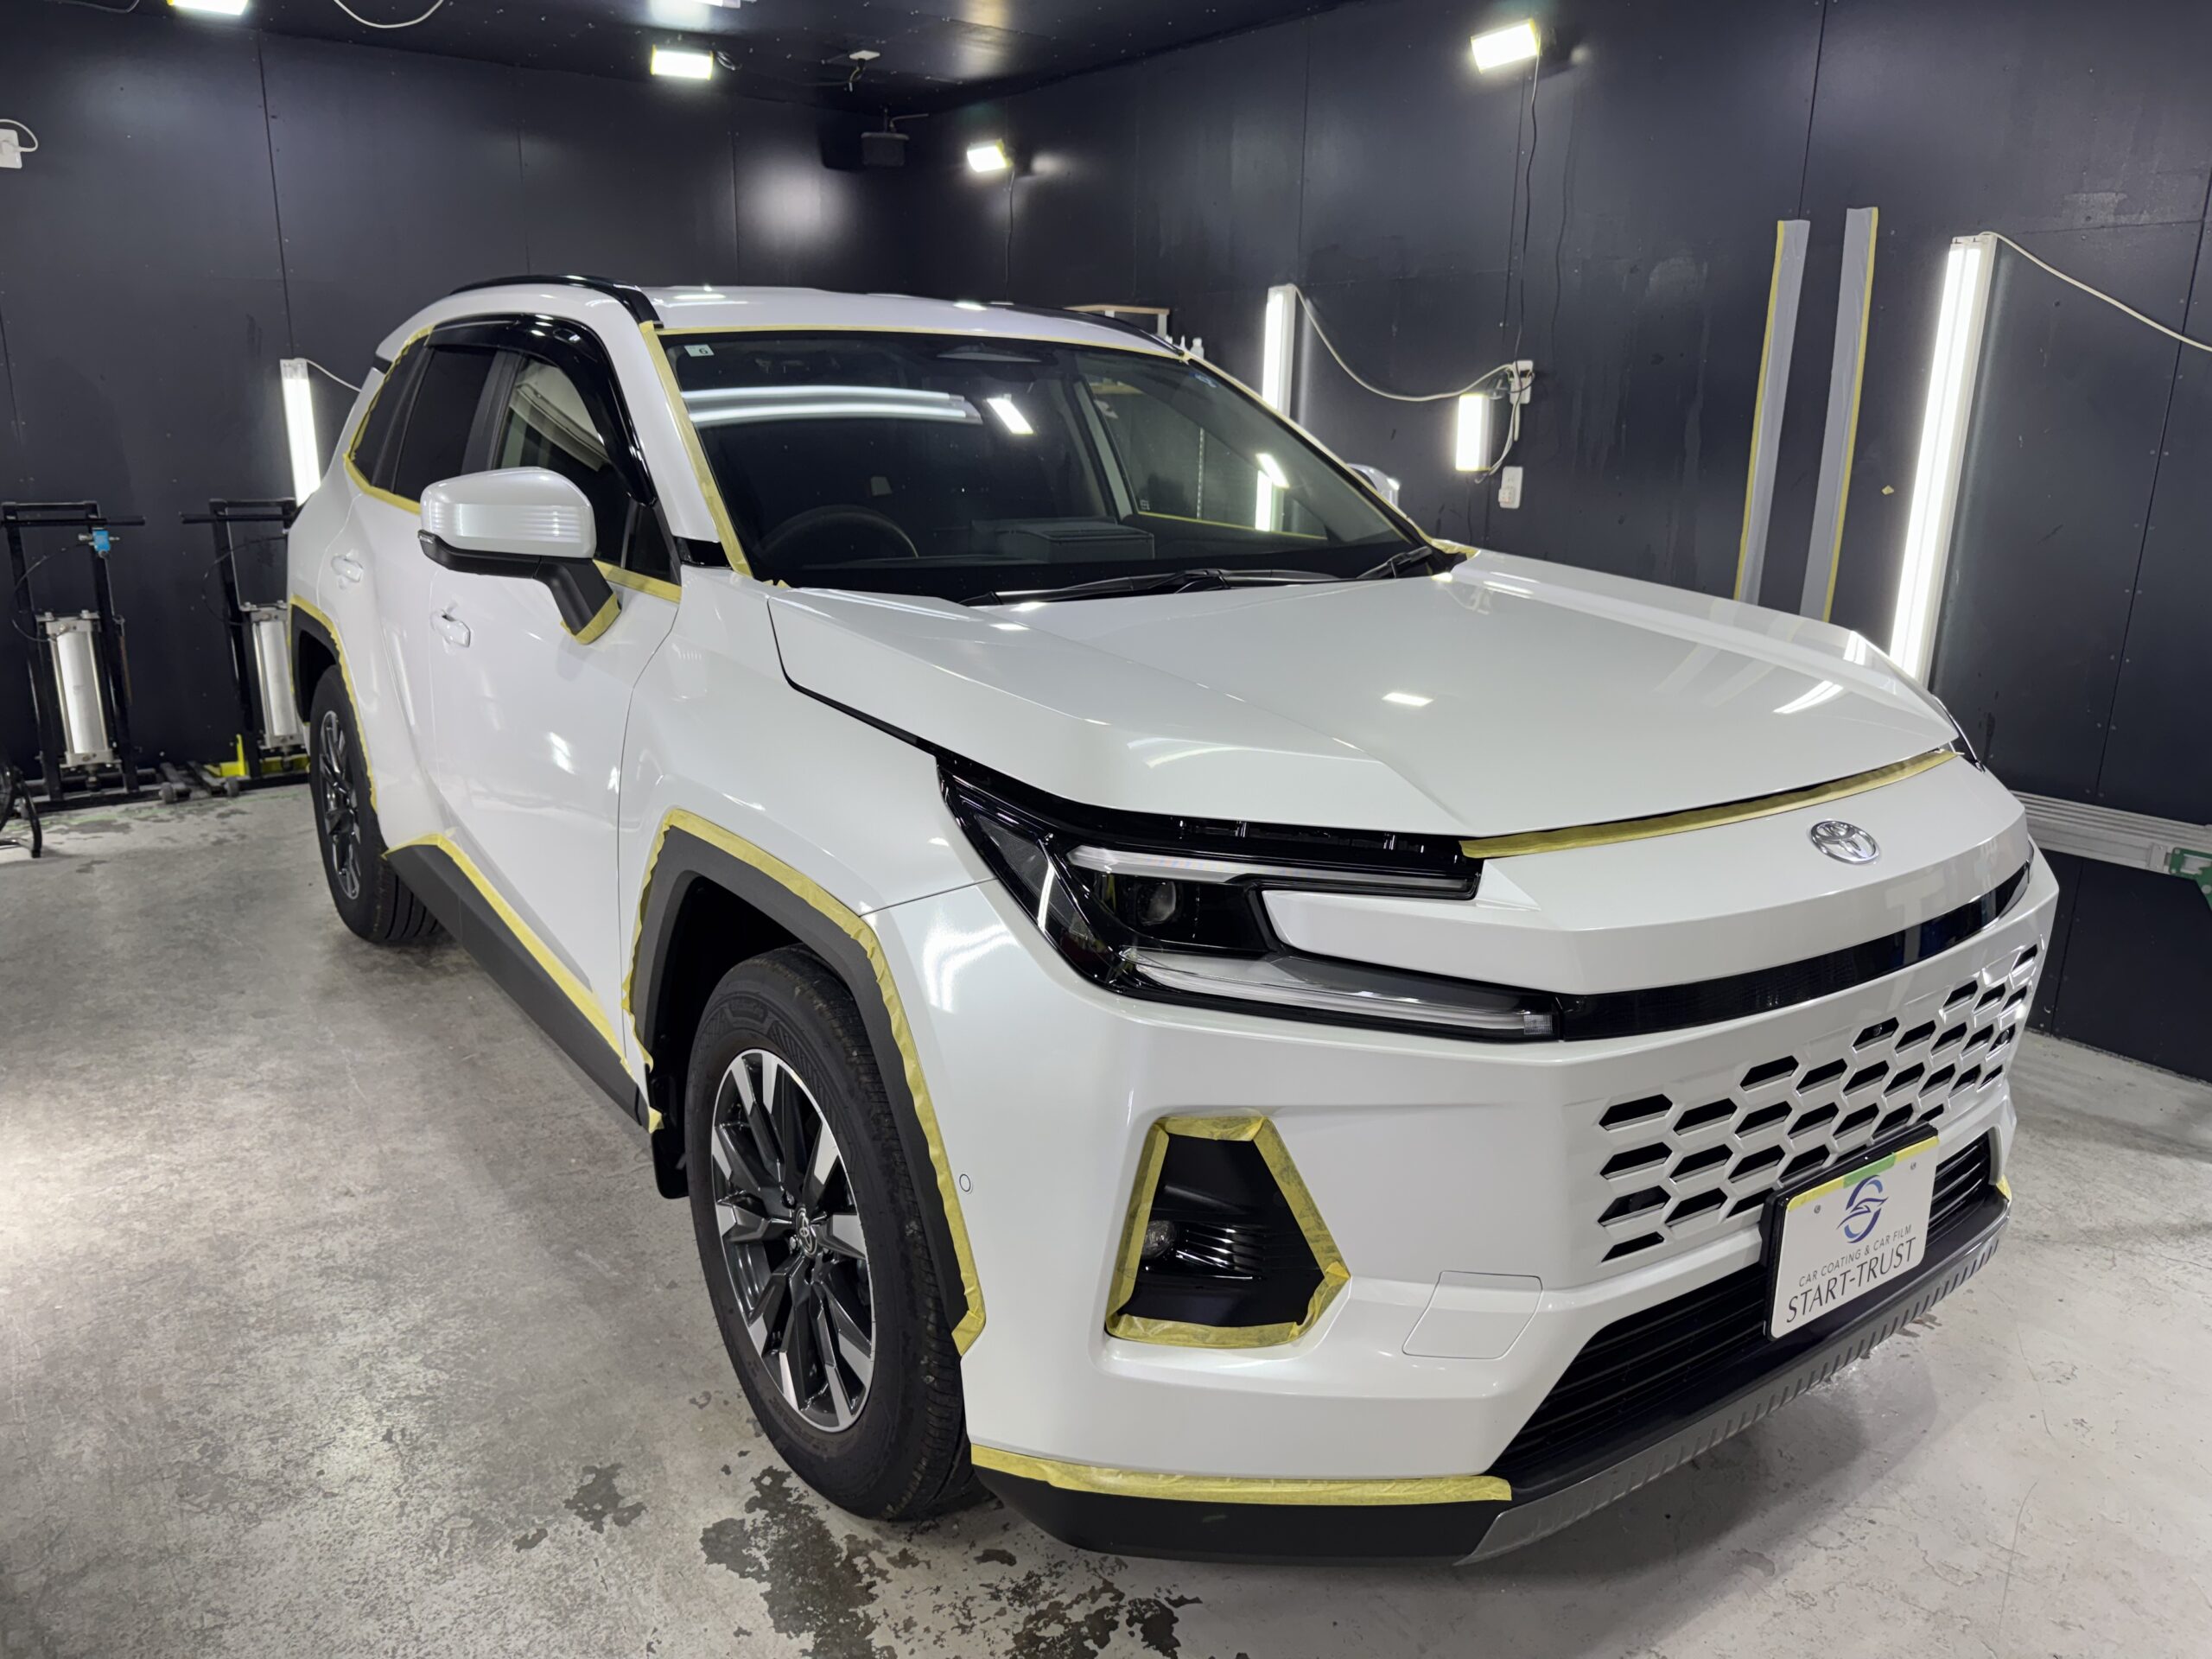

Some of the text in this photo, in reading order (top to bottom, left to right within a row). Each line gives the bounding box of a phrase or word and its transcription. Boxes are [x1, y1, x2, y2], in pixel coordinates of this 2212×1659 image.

[1786, 1236, 1916, 1323] START-TRUST
[1799, 1224, 1912, 1287] CAR COATING & CAR FILM
